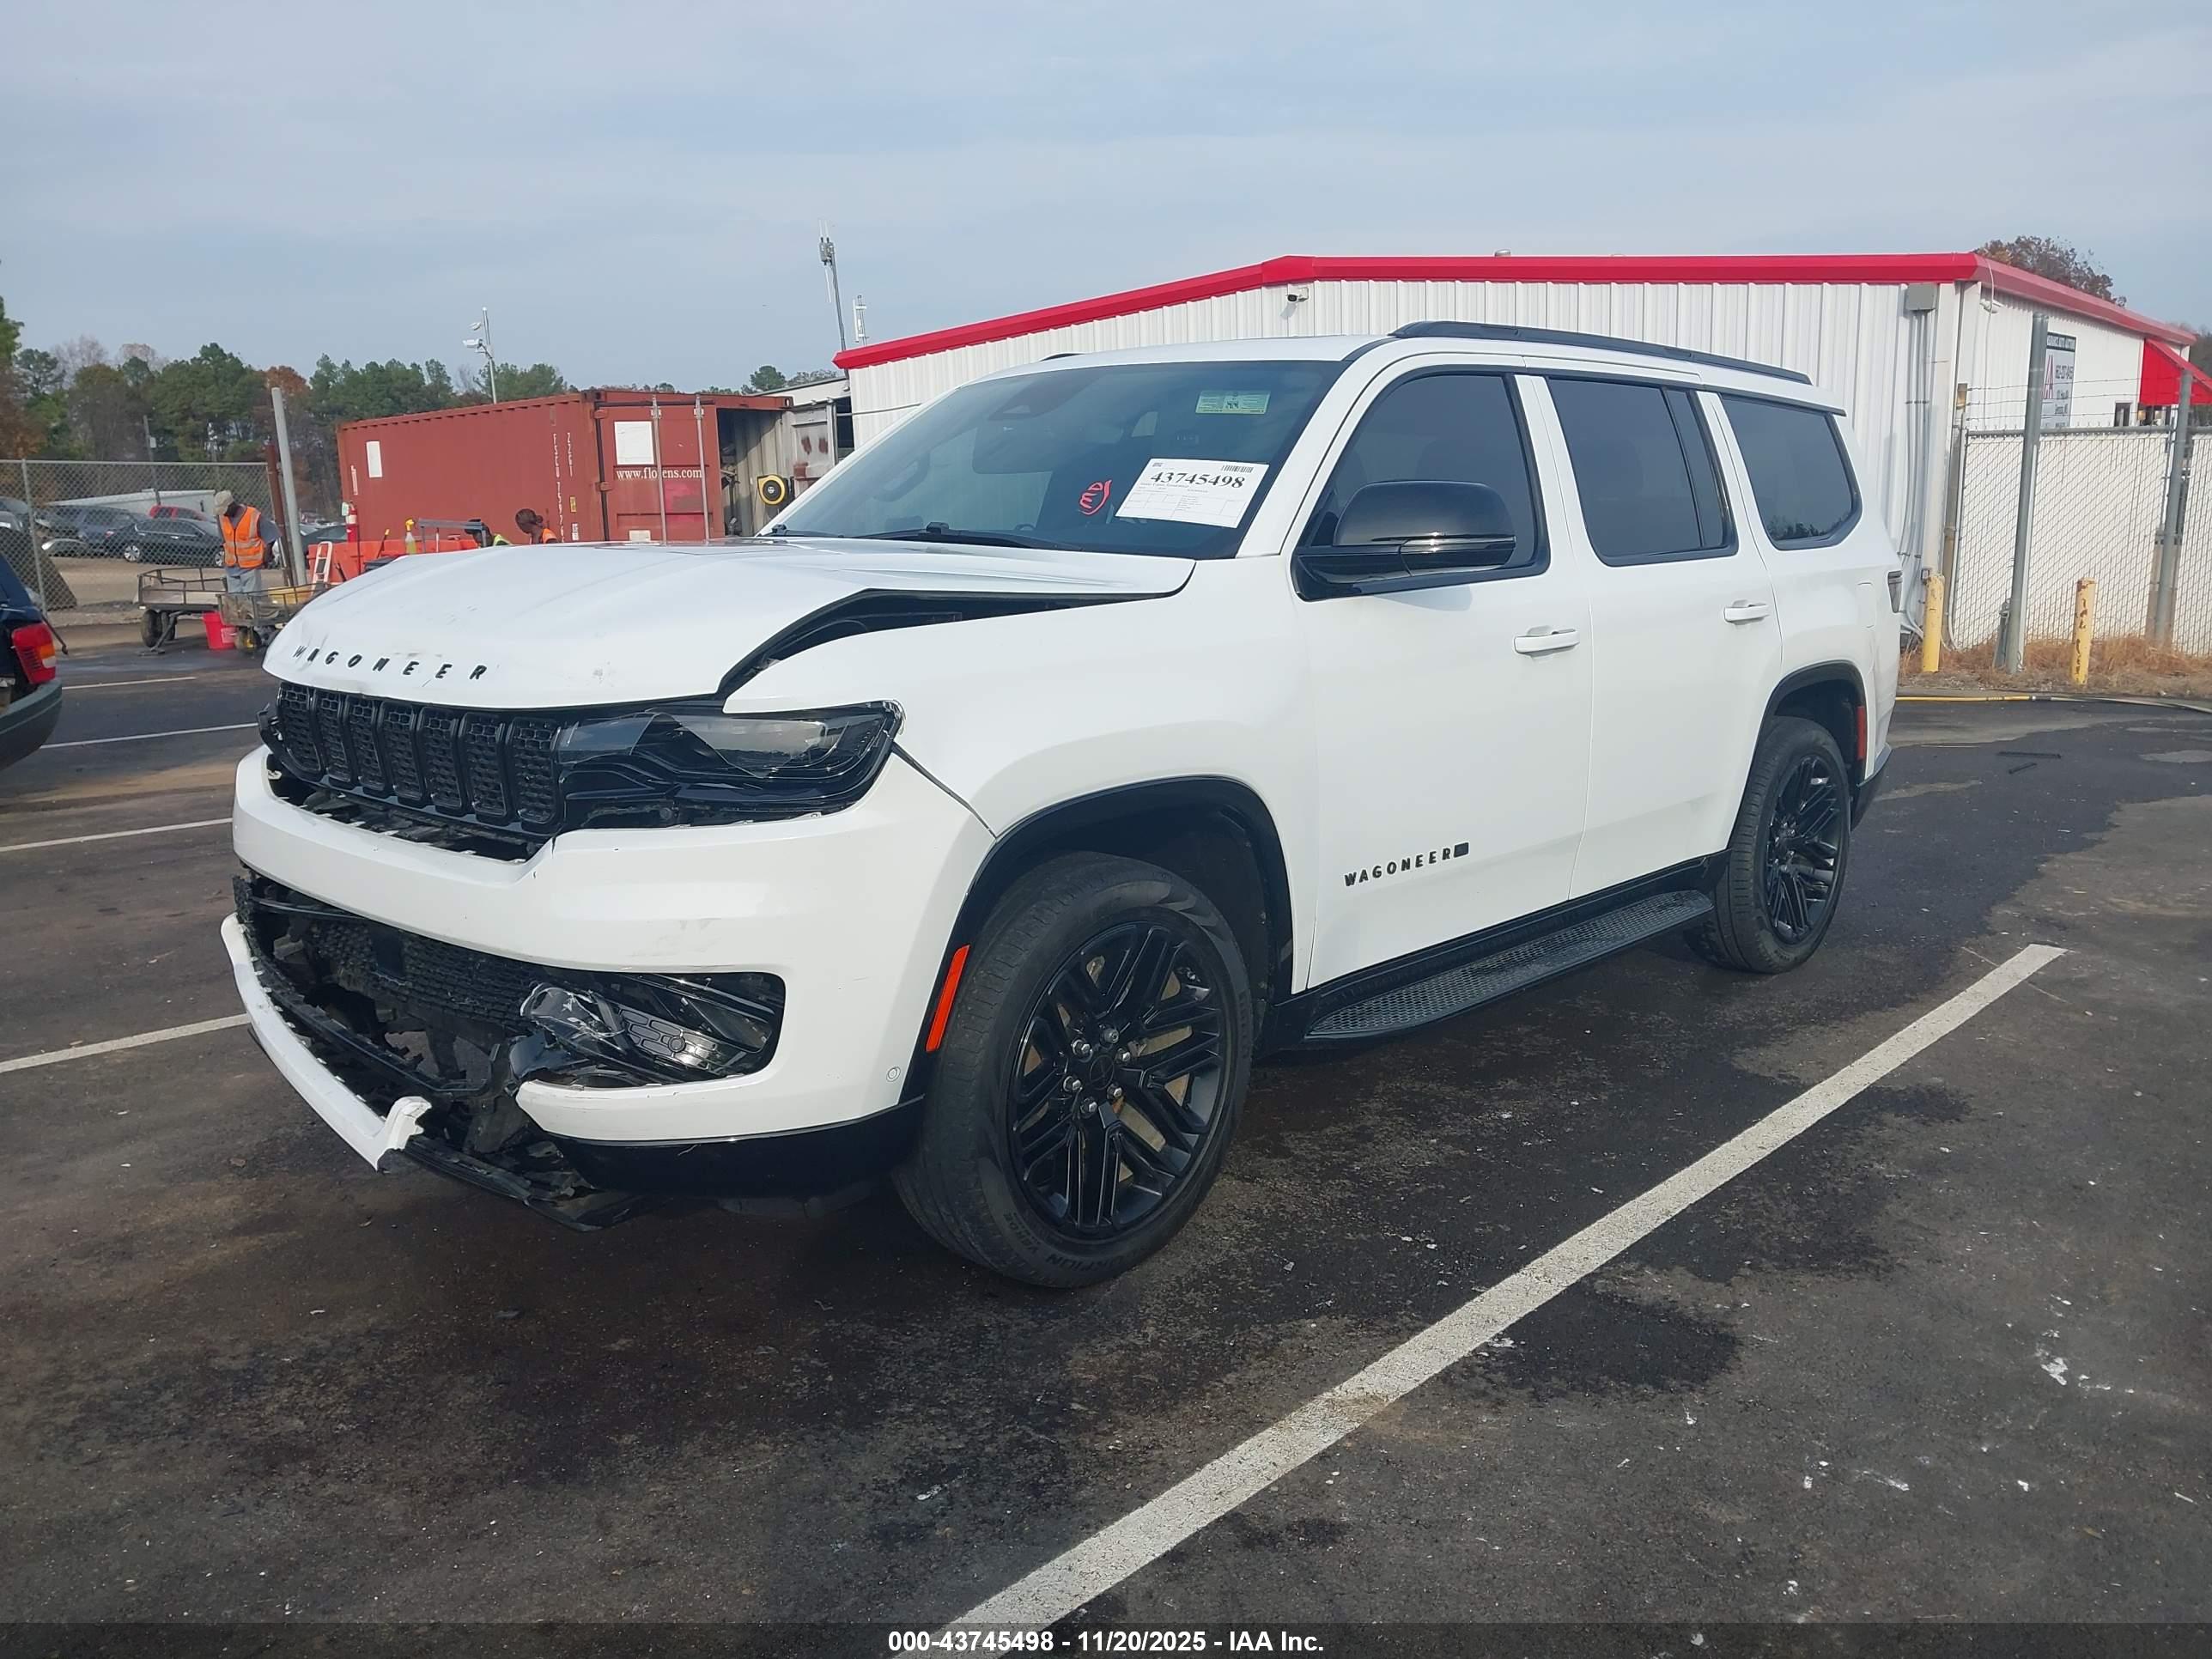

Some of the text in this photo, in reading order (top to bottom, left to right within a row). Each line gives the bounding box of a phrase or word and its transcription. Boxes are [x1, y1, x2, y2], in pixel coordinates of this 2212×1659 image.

[617, 467, 702, 481] www.floens.com
[1151, 471, 1245, 489] 43745498
[293, 645, 488, 680] WAGONEER
[1344, 848, 1451, 887] WAGONEER
